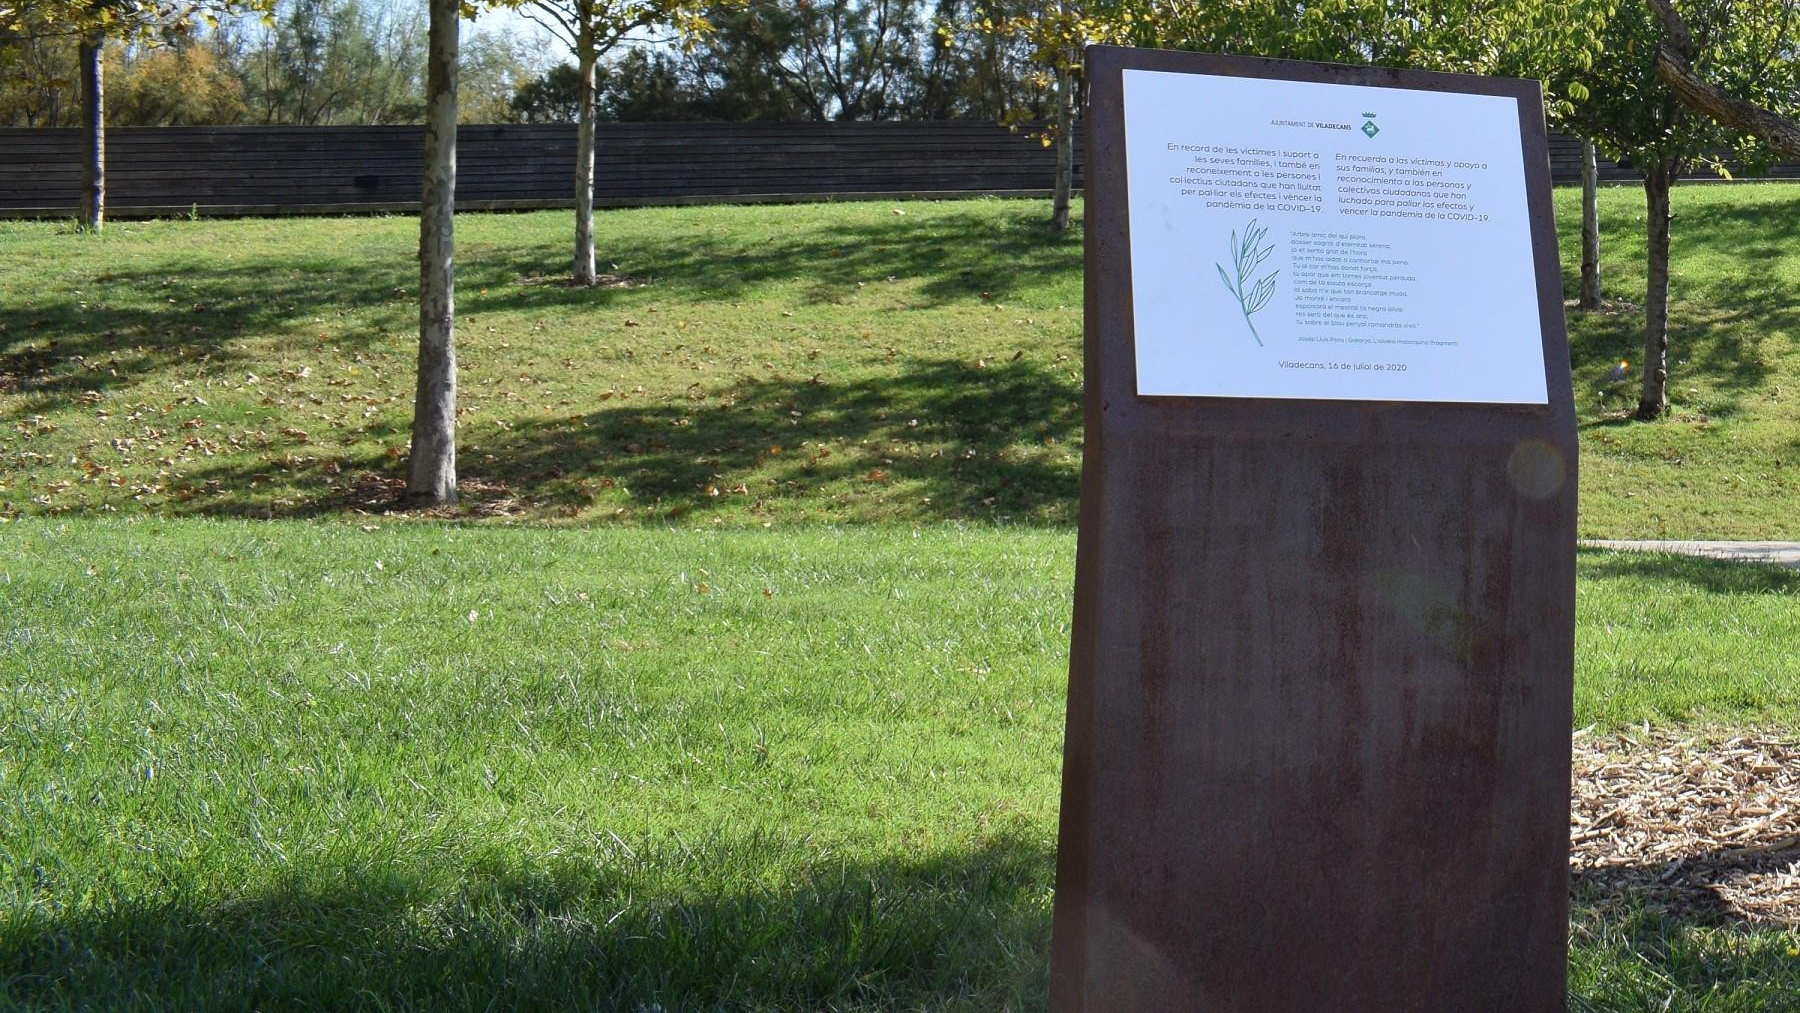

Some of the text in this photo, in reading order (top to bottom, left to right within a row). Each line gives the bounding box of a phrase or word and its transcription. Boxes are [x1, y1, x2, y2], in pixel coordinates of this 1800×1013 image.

[1315, 122, 1352, 130] VILADECANS
[1167, 142, 1179, 151] En
[1181, 144, 1210, 153] record
[1212, 145, 1223, 154] de
[1226, 146, 1238, 154] les
[1283, 150, 1311, 160] suport
[1194, 155, 1208, 164] les
[1335, 153, 1347, 161] En
[1349, 155, 1387, 164] recuerdo
[1396, 156, 1409, 165] las
[1446, 161, 1451, 170] y
[1454, 162, 1480, 171] apoyo
[1186, 167, 1251, 177] reconeixement
[1262, 169, 1275, 178] les
[1276, 172, 1316, 180] persones
[1352, 164, 1387, 175] familias,
[1389, 168, 1394, 176] y
[1215, 178, 1258, 188] ciutadans
[1260, 182, 1277, 190] que
[1279, 181, 1296, 190] han
[1297, 182, 1321, 191] lluitat
[1337, 175, 1403, 185] reconocimiento
[1412, 177, 1424, 186] las
[1426, 180, 1465, 189] personas
[1466, 182, 1472, 191] y
[1181, 189, 1196, 197] per
[1229, 189, 1242, 198] els
[1244, 190, 1277, 200] efectes
[1314, 193, 1322, 202] la
[1337, 185, 1467, 200] colectivos ciudadanos que han
[1253, 201, 1265, 210] de
[1267, 202, 1275, 210] la
[1338, 195, 1475, 212] luchado para paliar los efectos y
[1370, 207, 1378, 216] la
[1380, 208, 1423, 218] pandemia
[1425, 210, 1436, 219] de
[1437, 210, 1445, 219] la
[1278, 361, 1407, 372] Viladecans, 16 de juliol de 2020
